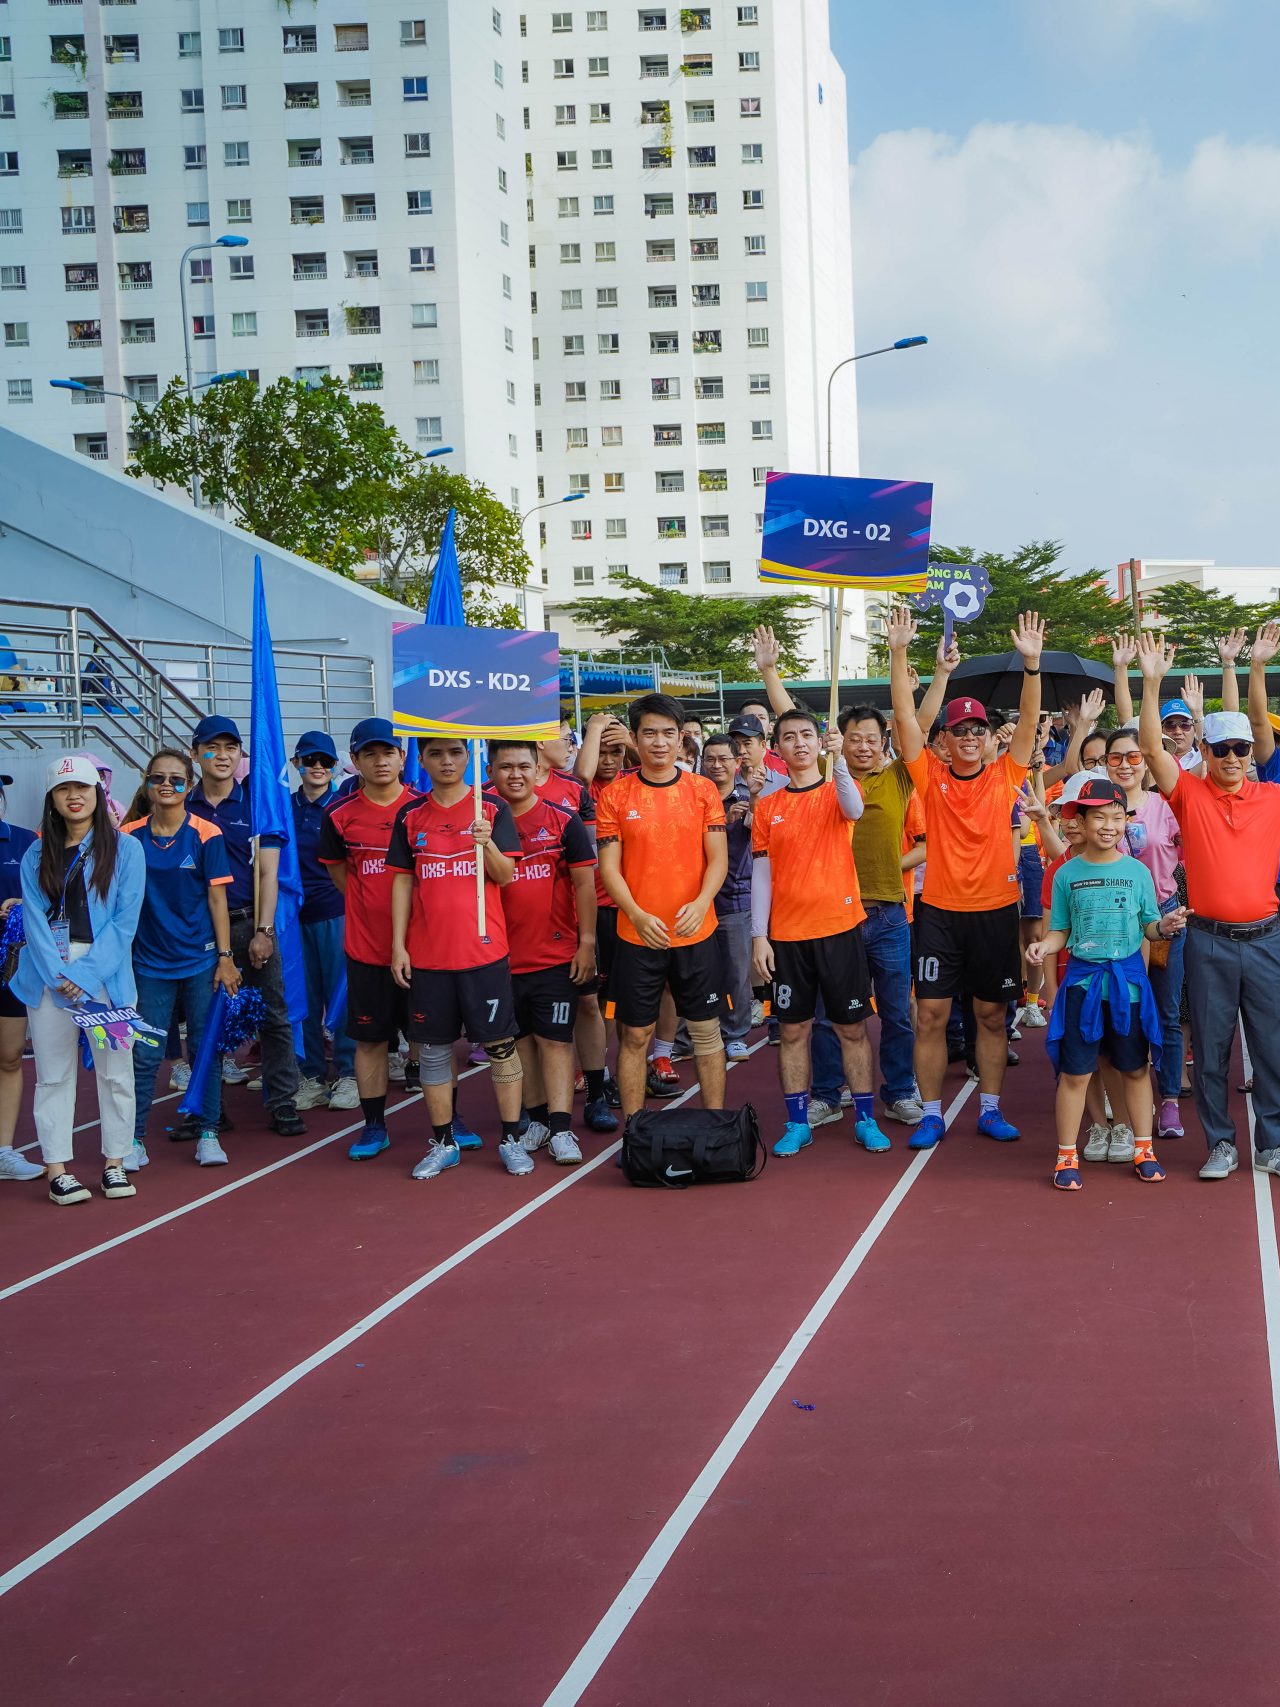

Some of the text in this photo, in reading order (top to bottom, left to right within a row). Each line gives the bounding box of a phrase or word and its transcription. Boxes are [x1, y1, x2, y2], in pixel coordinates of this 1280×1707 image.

[803, 518, 848, 539] DXG
[865, 523, 891, 542] 02
[928, 565, 972, 581] ÓNG ĐÁ
[927, 580, 944, 590] AM
[428, 669, 471, 689] DXS
[488, 672, 531, 692] KD2
[58, 759, 74, 776] A
[1105, 878, 1134, 889] SHARKS
[918, 956, 940, 982] 10
[74, 1008, 141, 1027] BOWLING
[486, 999, 499, 1023] 7
[551, 1002, 571, 1025] 10
